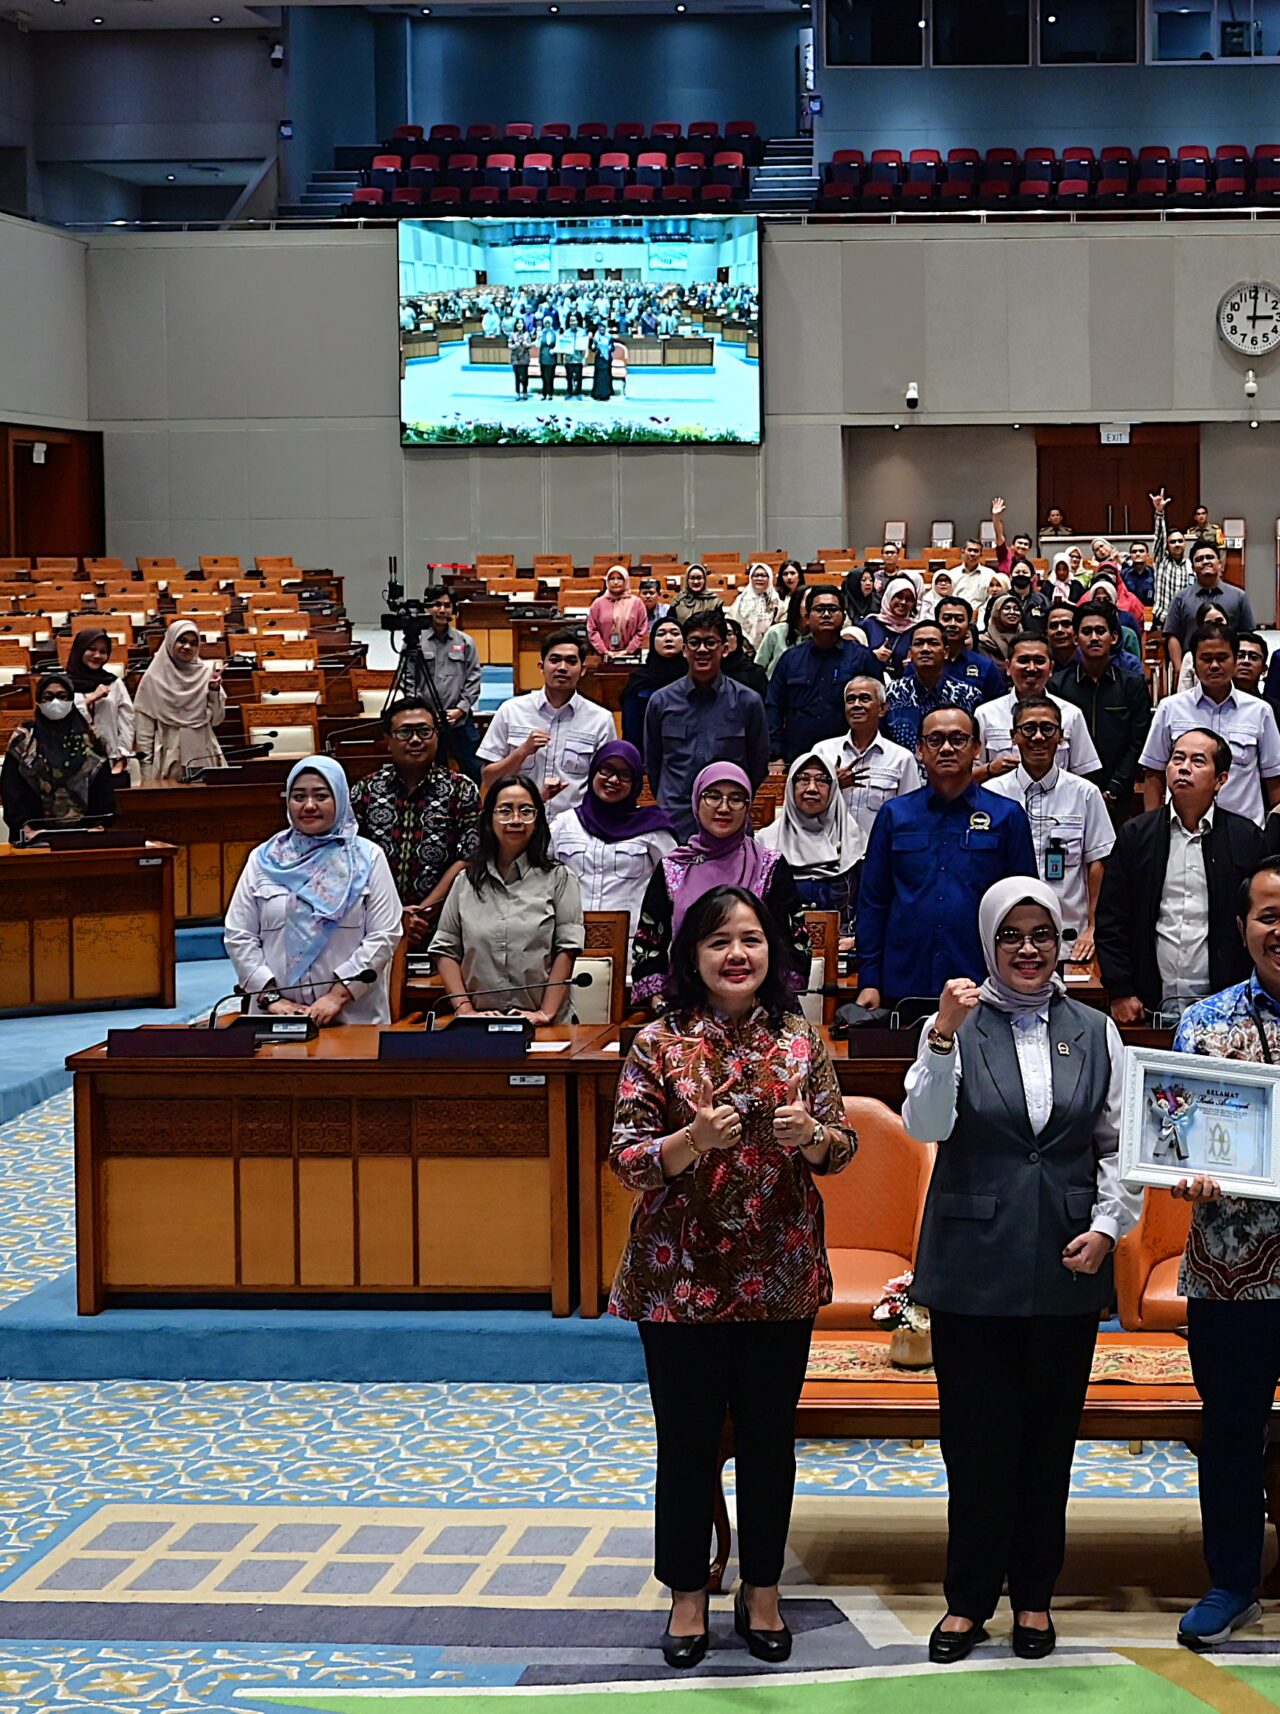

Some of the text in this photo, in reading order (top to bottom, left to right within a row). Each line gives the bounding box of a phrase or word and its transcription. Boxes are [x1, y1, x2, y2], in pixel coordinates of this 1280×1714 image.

[1240, 292, 1247, 303] 11
[1230, 302, 1240, 312] 10
[1271, 300, 1279, 310] 2
[1226, 313, 1234, 323] 9
[1230, 325, 1238, 335] 8
[1271, 325, 1278, 334] 4
[1240, 333, 1248, 343] 7
[1250, 336, 1258, 346] 6
[1262, 333, 1269, 343] 5
[1106, 433, 1122, 442] EXIT
[1206, 1089, 1239, 1099] SELAMAT
